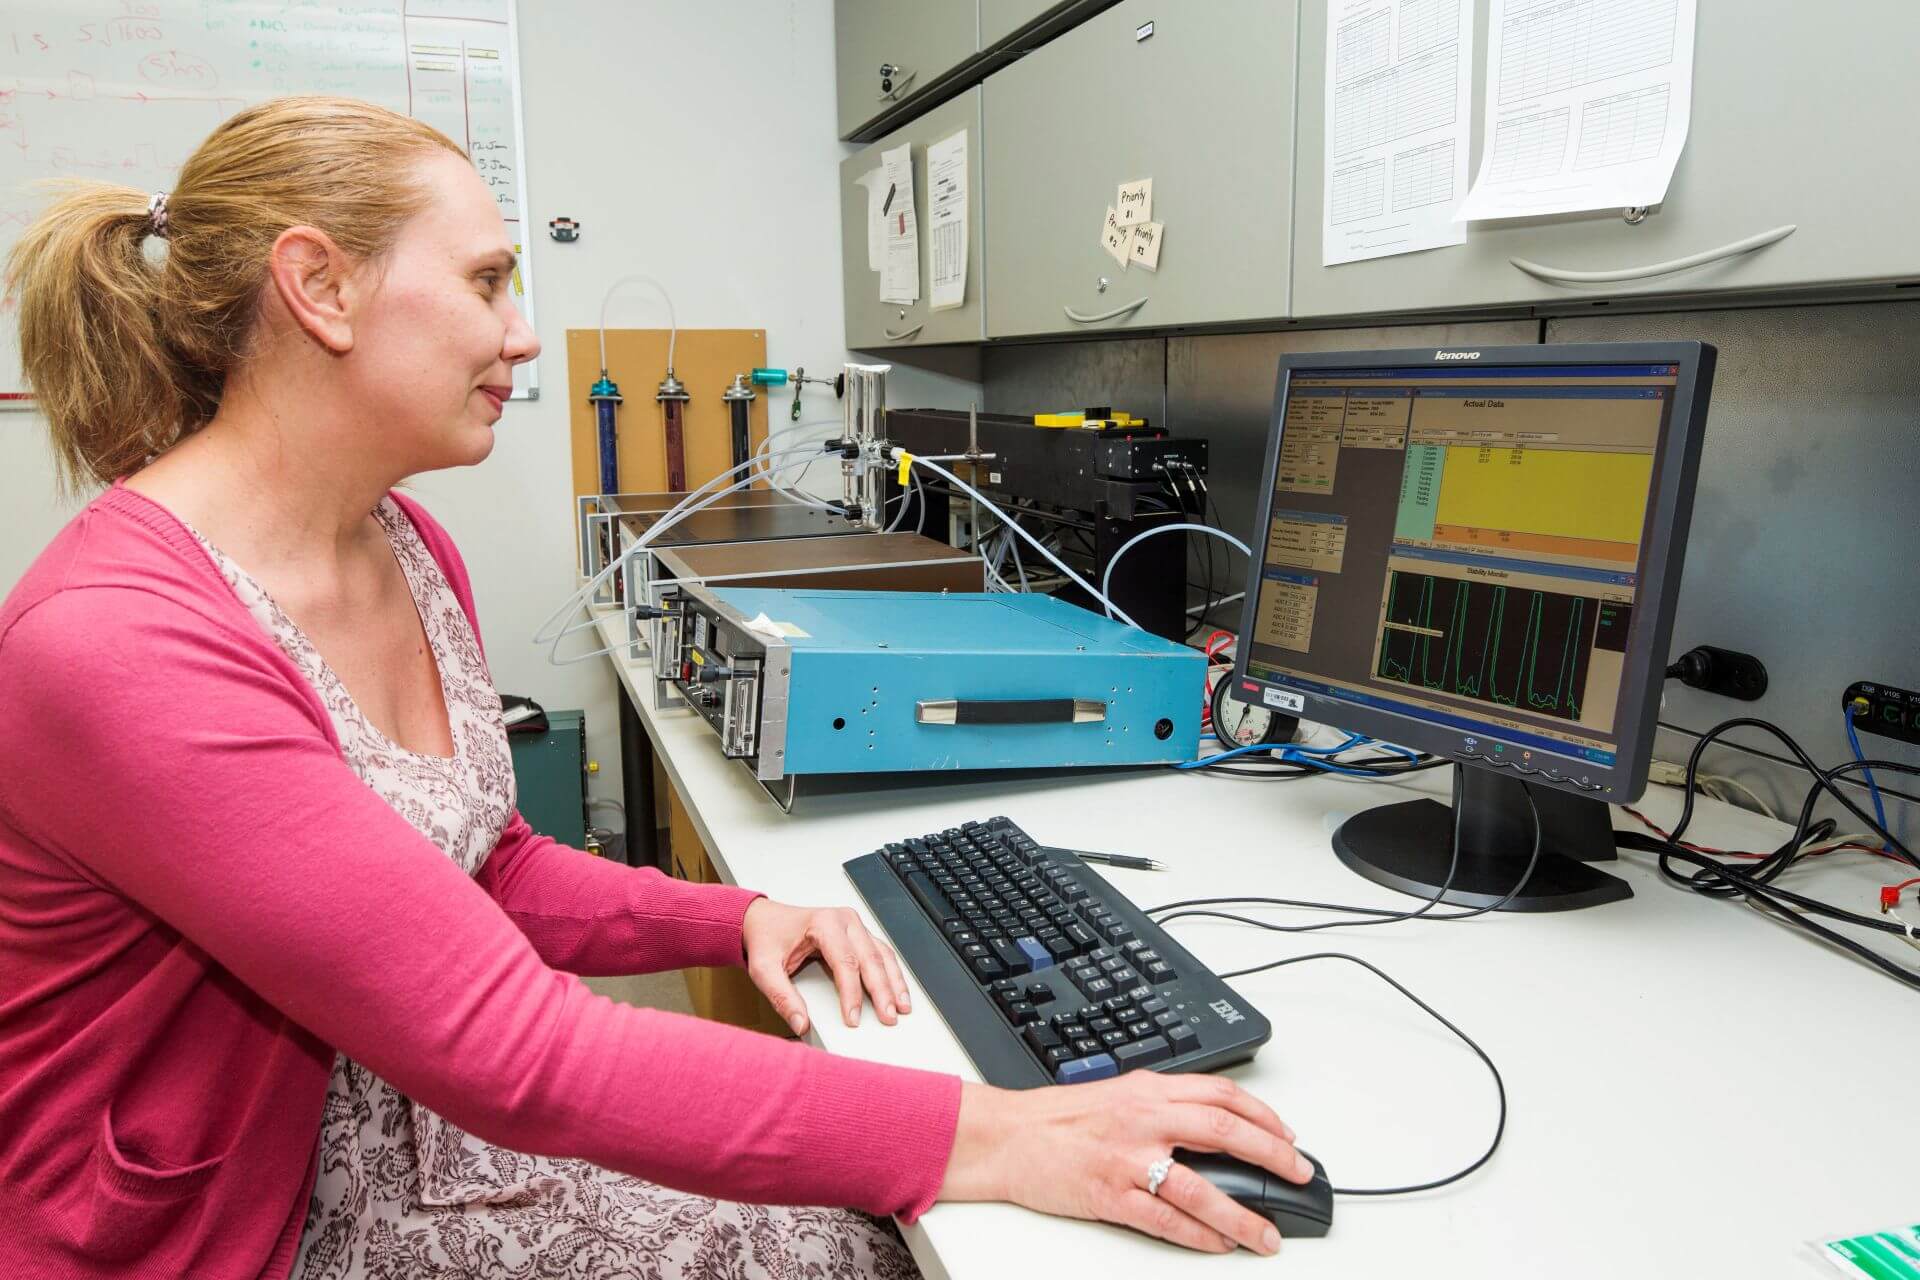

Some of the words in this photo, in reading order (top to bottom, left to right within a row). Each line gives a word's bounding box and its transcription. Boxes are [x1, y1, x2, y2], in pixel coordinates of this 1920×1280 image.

[1121, 187, 1147, 207] Priority
[1434, 350, 1481, 361] lenovo
[1463, 400, 1486, 408] Actual
[1487, 400, 1505, 408] Data
[1467, 567, 1488, 577] Stability
[1208, 999, 1246, 1025] IBM
